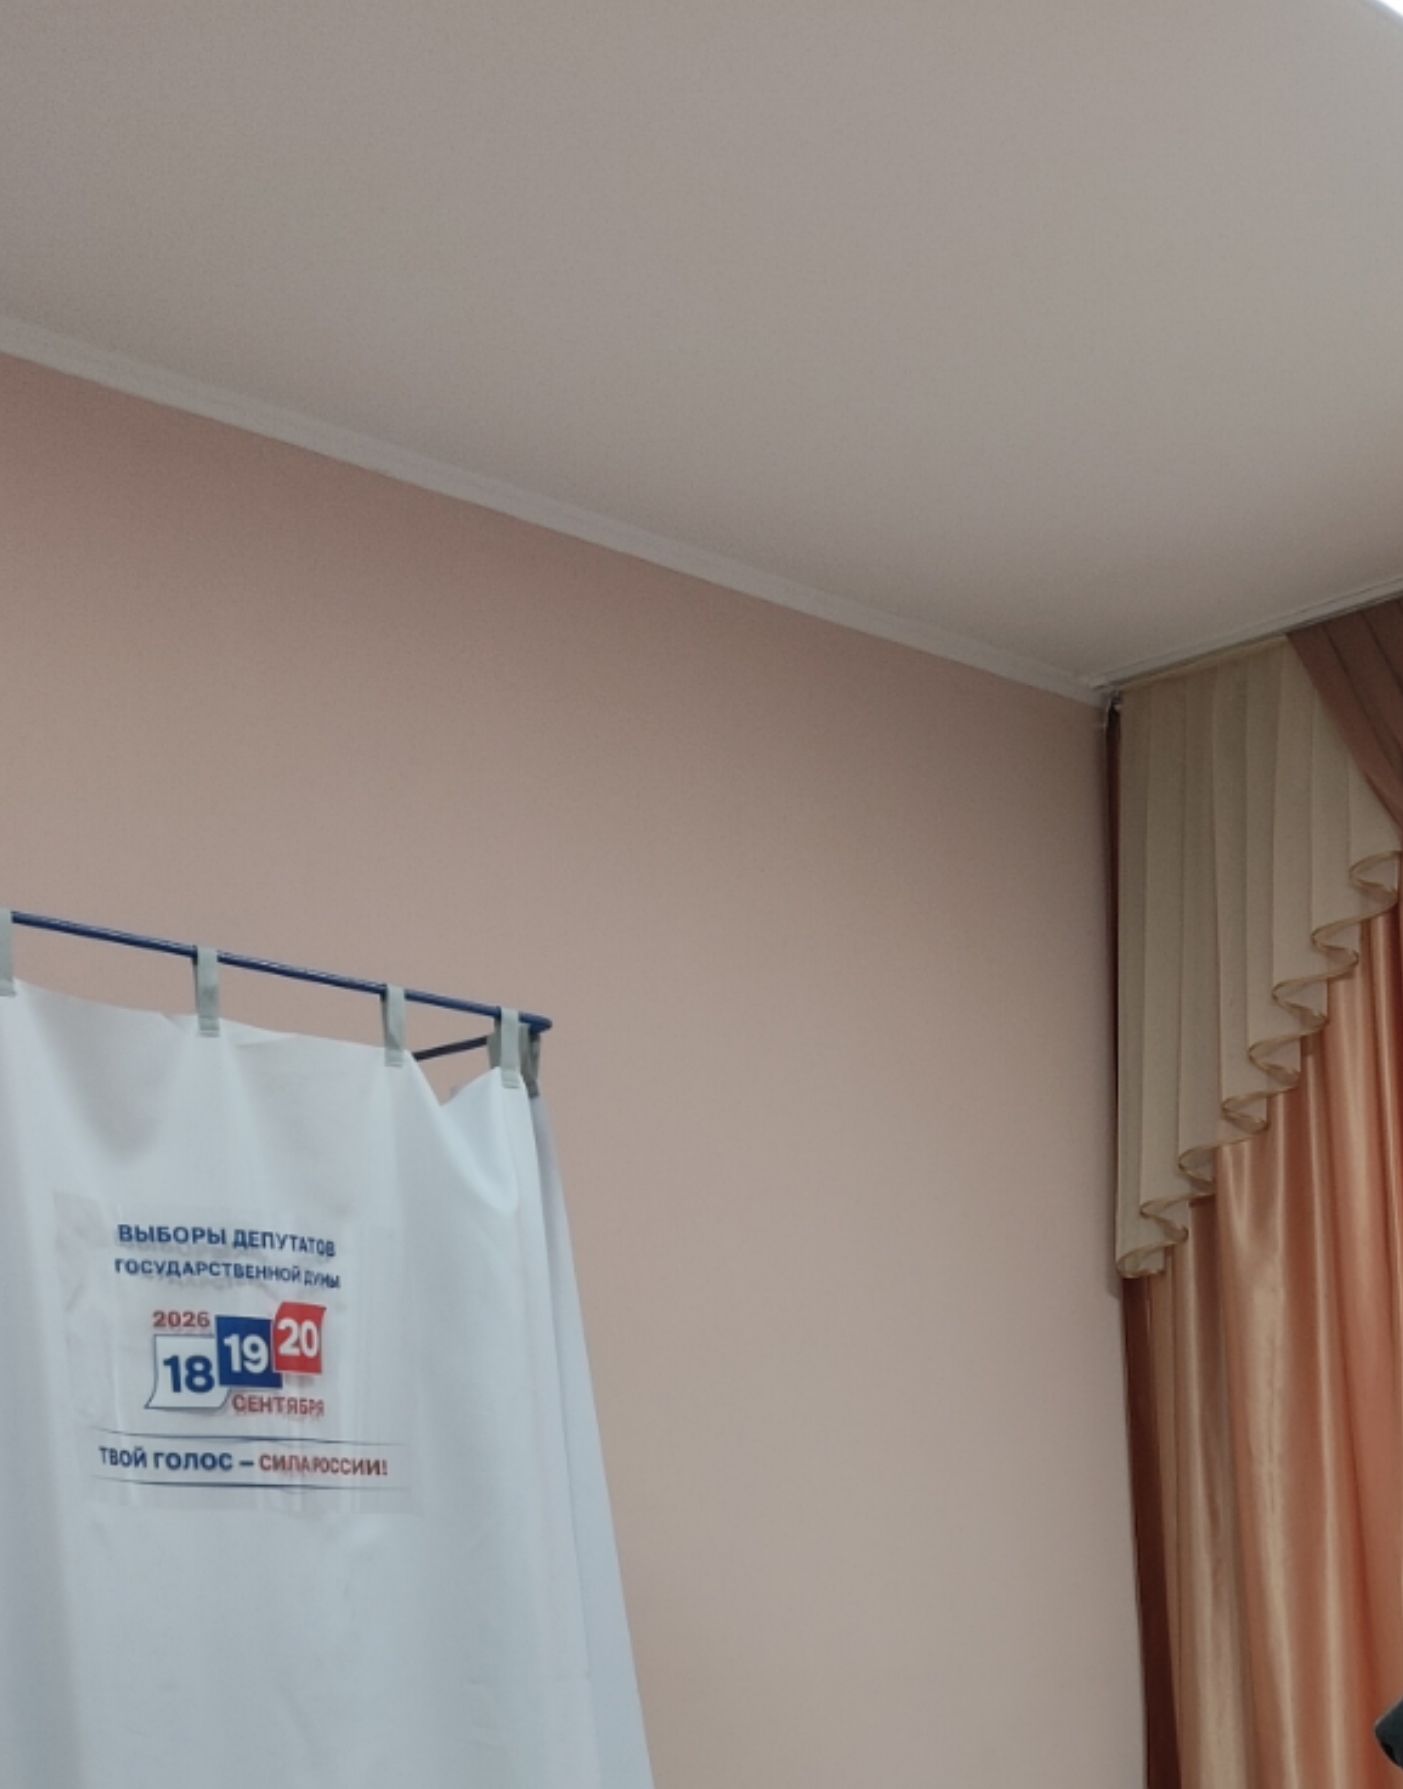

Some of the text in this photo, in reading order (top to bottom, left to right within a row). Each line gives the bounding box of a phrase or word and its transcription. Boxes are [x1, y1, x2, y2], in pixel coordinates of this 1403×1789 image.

[117, 1224, 336, 1258] ВЫБОРЫ ДЕПУТАТОВ
[114, 1258, 341, 1289] ГОСУДАРСТВЕННОЙ ДУМЫ
[153, 1310, 211, 1328] 2026
[163, 1318, 319, 1394] 18 19 20
[231, 1394, 325, 1416] СЕНТЯБРЯ
[98, 1446, 148, 1468] ТВОЙ
[153, 1452, 233, 1471] ГОЛОС
[259, 1454, 313, 1473] СИЛА
[313, 1457, 389, 1476] РОССИИ!
